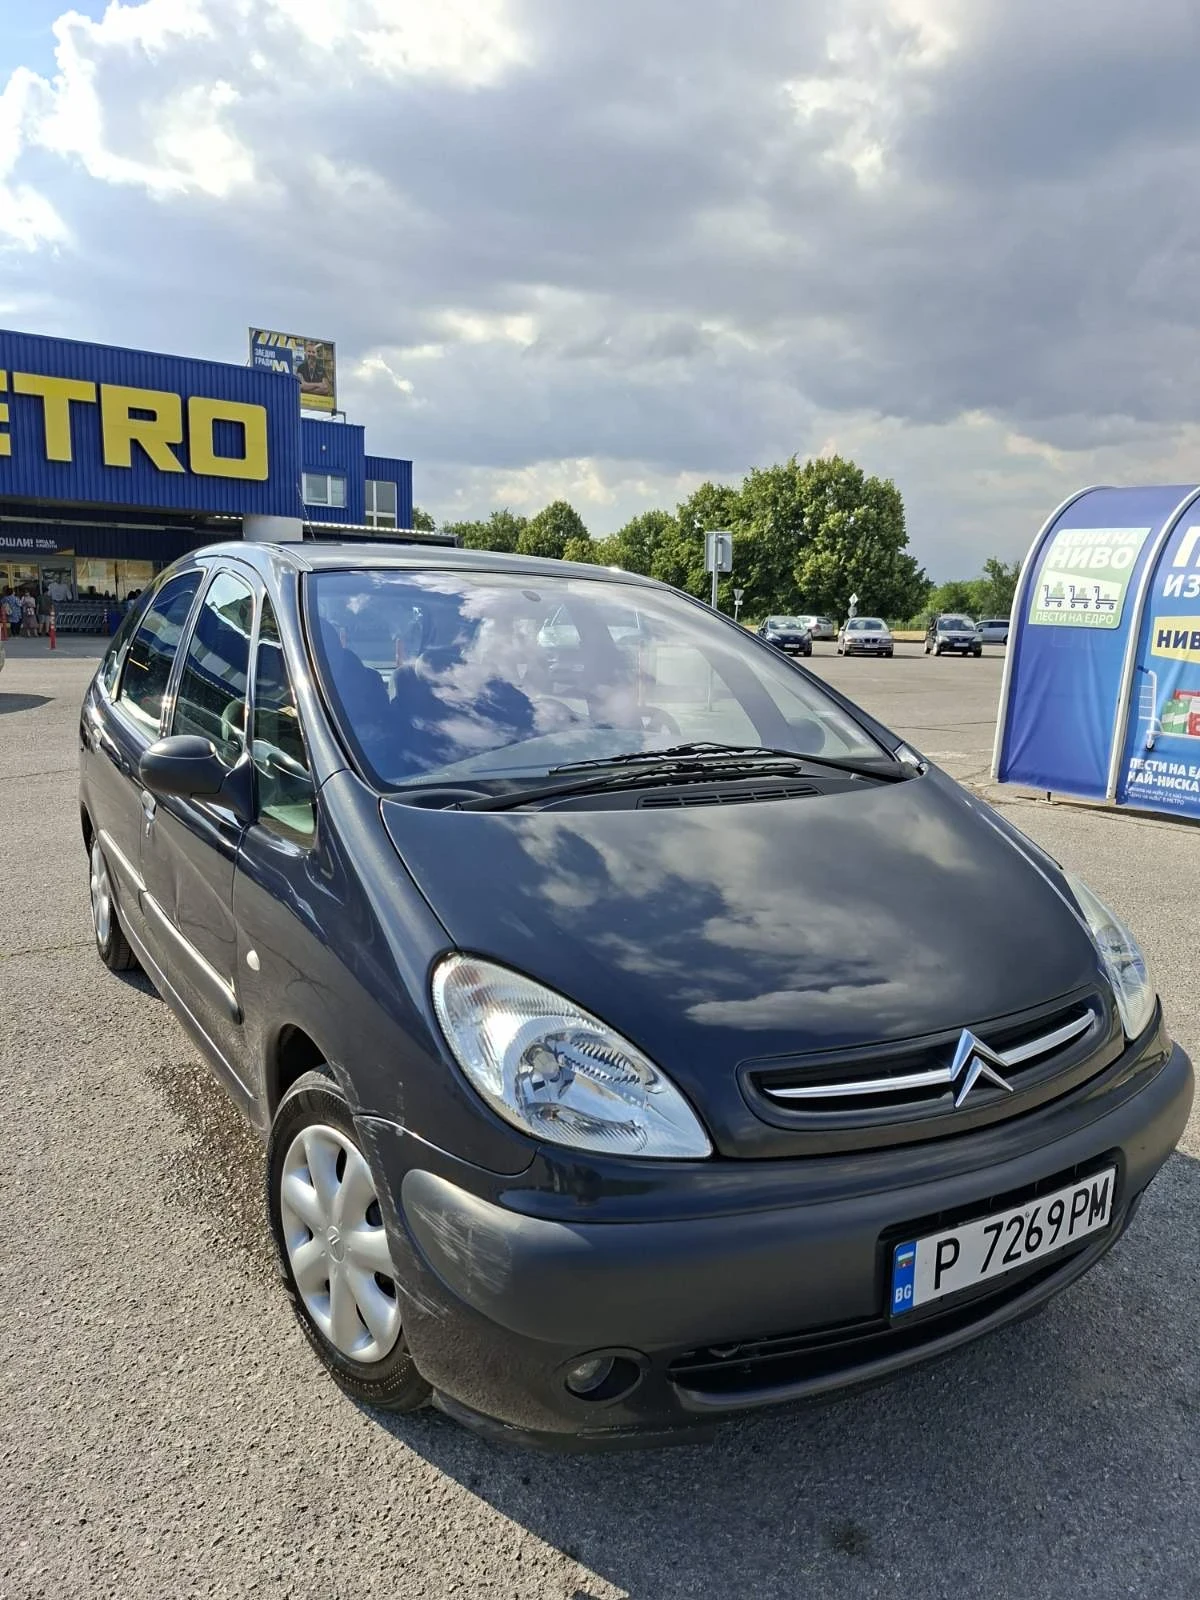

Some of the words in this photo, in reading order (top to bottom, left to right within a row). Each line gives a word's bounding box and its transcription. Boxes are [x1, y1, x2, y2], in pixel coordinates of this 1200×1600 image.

[0, 369, 268, 481] TRO
[1049, 546, 1134, 569] НИВО
[1035, 611, 1067, 622] ПЕСТИ
[1068, 613, 1082, 623] НА
[1084, 613, 1114, 625] ЕДРО
[1130, 757, 1168, 773] ПЕСТИ
[1168, 762, 1187, 776] НА
[934, 1237, 961, 1290] P
[895, 1284, 912, 1304] BG
